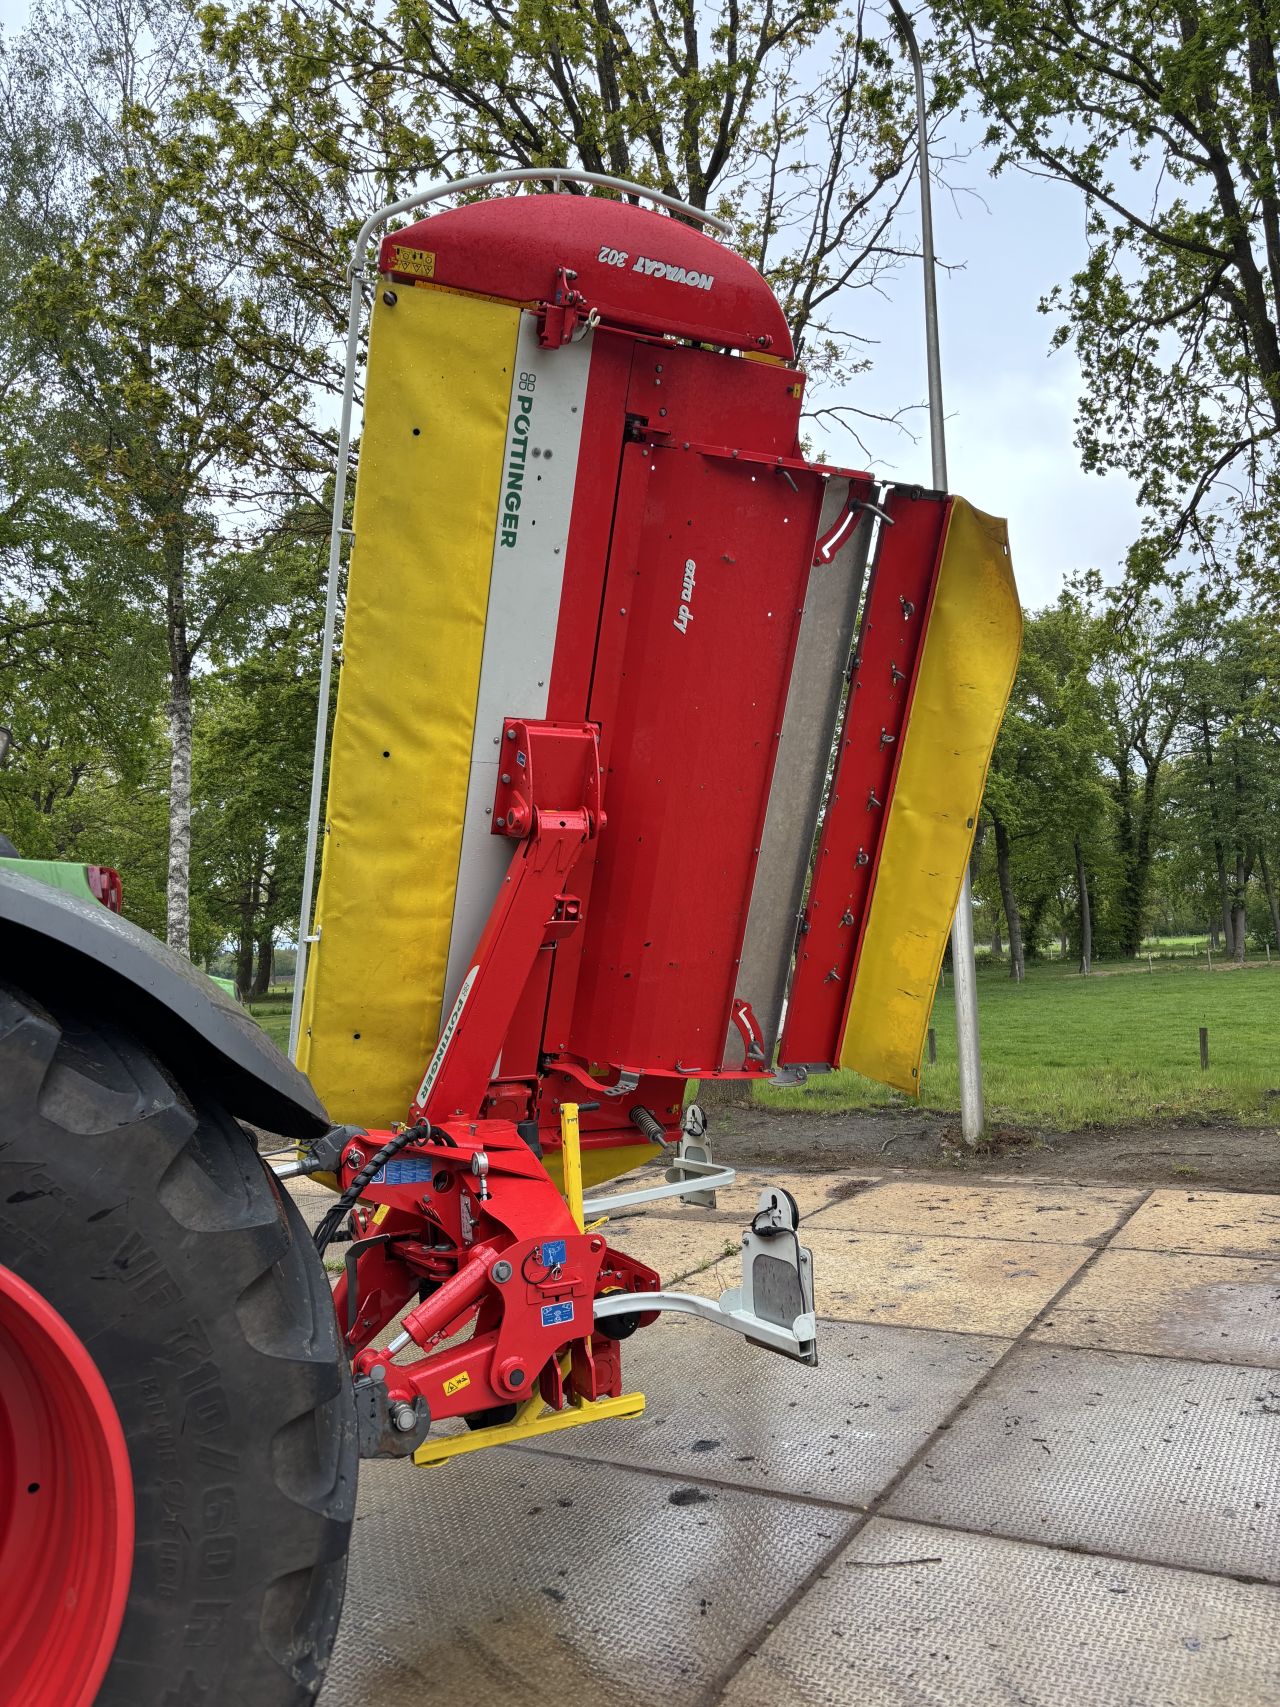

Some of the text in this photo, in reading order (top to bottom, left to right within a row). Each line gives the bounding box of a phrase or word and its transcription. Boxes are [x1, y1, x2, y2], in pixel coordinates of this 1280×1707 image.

[598, 246, 714, 290] NOVACAT 302
[673, 558, 696, 635] extra dry
